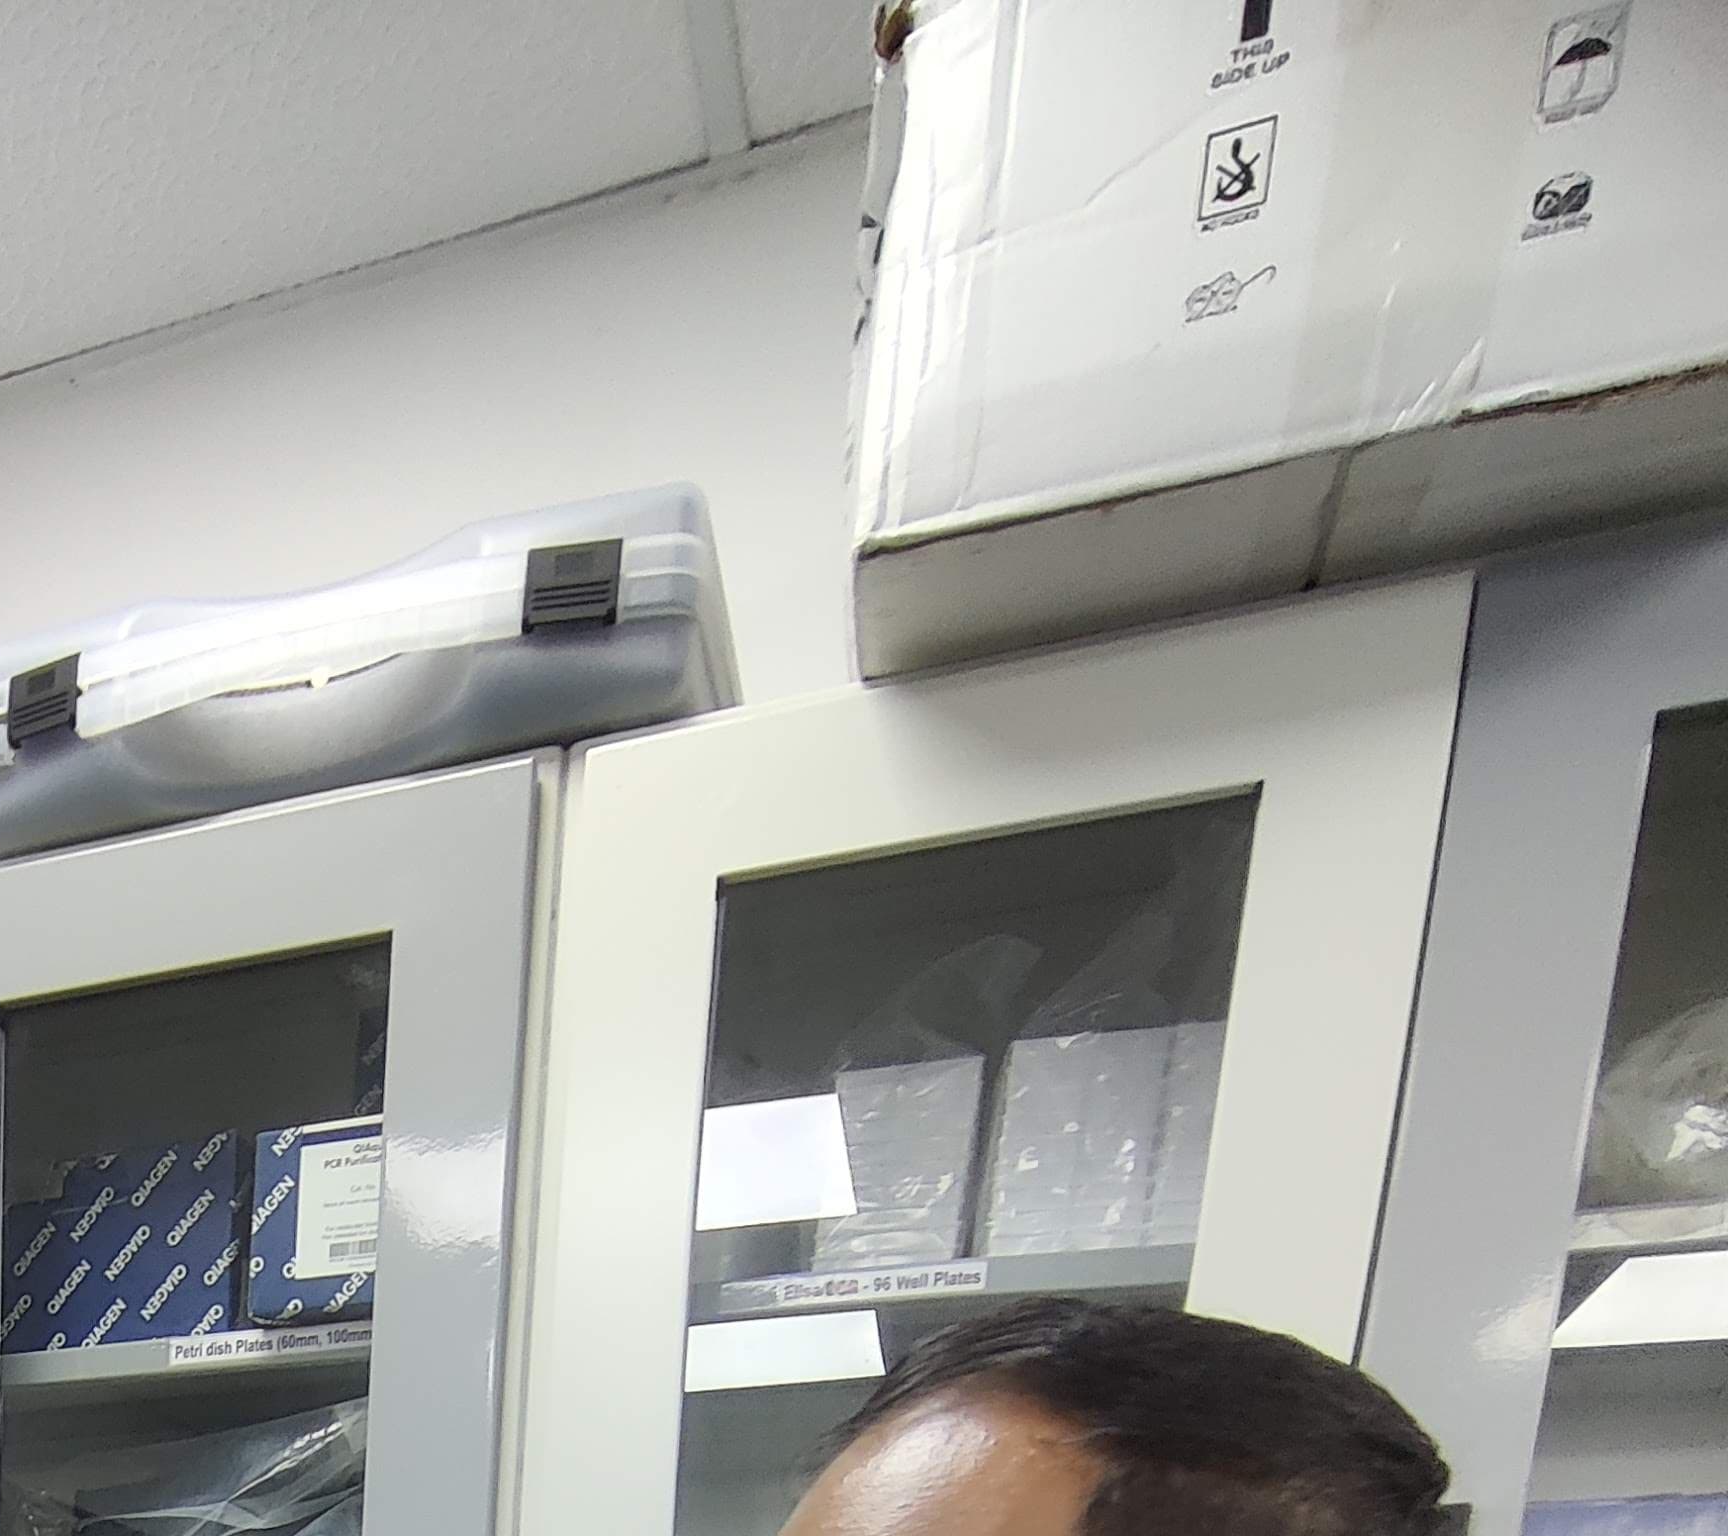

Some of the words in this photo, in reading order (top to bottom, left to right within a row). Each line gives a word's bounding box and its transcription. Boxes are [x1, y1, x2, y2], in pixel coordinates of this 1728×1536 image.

[1211, 62, 1257, 89] SIDE
[1261, 51, 1291, 74] UP
[1230, 38, 1275, 63] THIS
[131, 1149, 179, 1207] QIAGEN
[70, 1185, 115, 1243] QIAGEN
[166, 1187, 216, 1248] QIAGEN
[12, 1219, 57, 1278] QIAGEN
[104, 1223, 152, 1282] QIAGEN
[46, 1258, 93, 1316] QIAGEN
[139, 1262, 188, 1322] QIAGEN
[873, 1276, 891, 1292] 96
[896, 1272, 929, 1290] Well
[933, 1269, 981, 1286] Plates
[175, 1343, 203, 1359] Petri
[207, 1340, 233, 1357] dish
[236, 1337, 273, 1353] Plates
